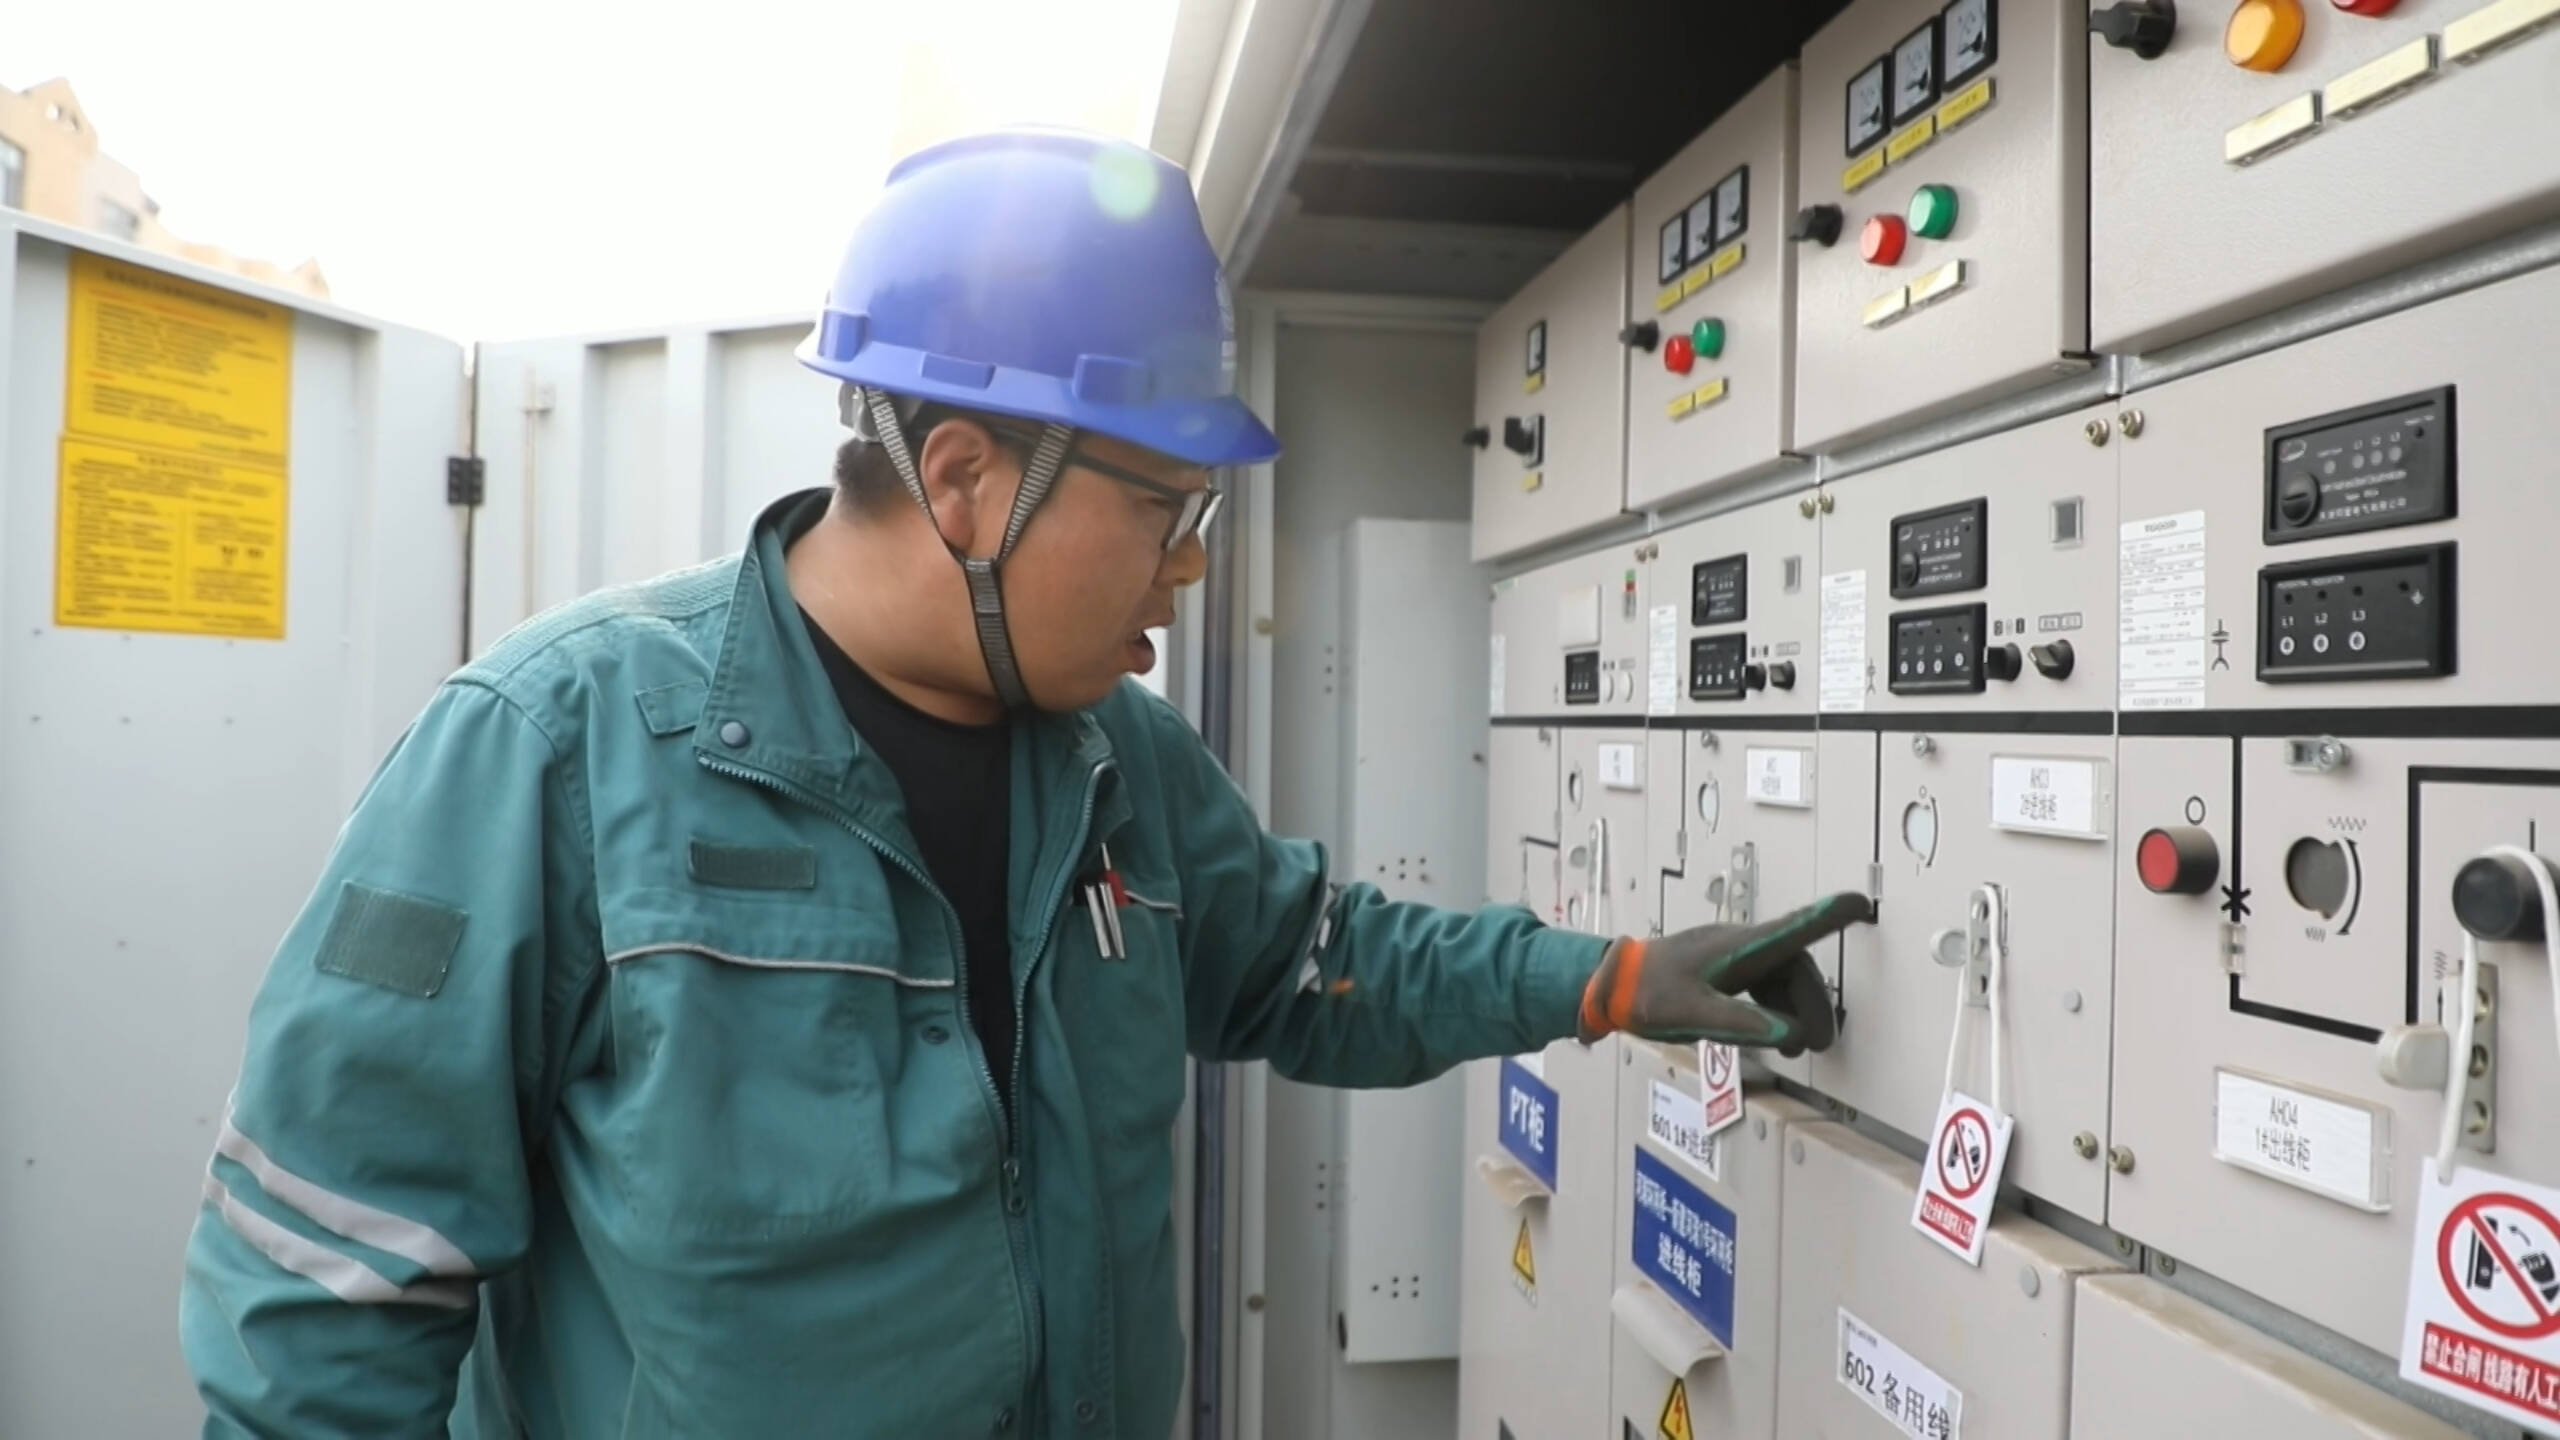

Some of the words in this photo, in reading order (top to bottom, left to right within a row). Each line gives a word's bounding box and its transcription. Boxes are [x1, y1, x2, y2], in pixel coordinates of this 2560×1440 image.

[2281, 616, 2295, 627] L1
[2314, 613, 2329, 625] L2
[2351, 610, 2366, 622] L3
[1509, 1084, 1545, 1154] PT柜
[1657, 1231, 1702, 1299] 进线柜
[1844, 1351, 1877, 1397] 602
[1881, 1369, 1952, 1440] 备用线
[2482, 1350, 2560, 1415] 线路有人工
